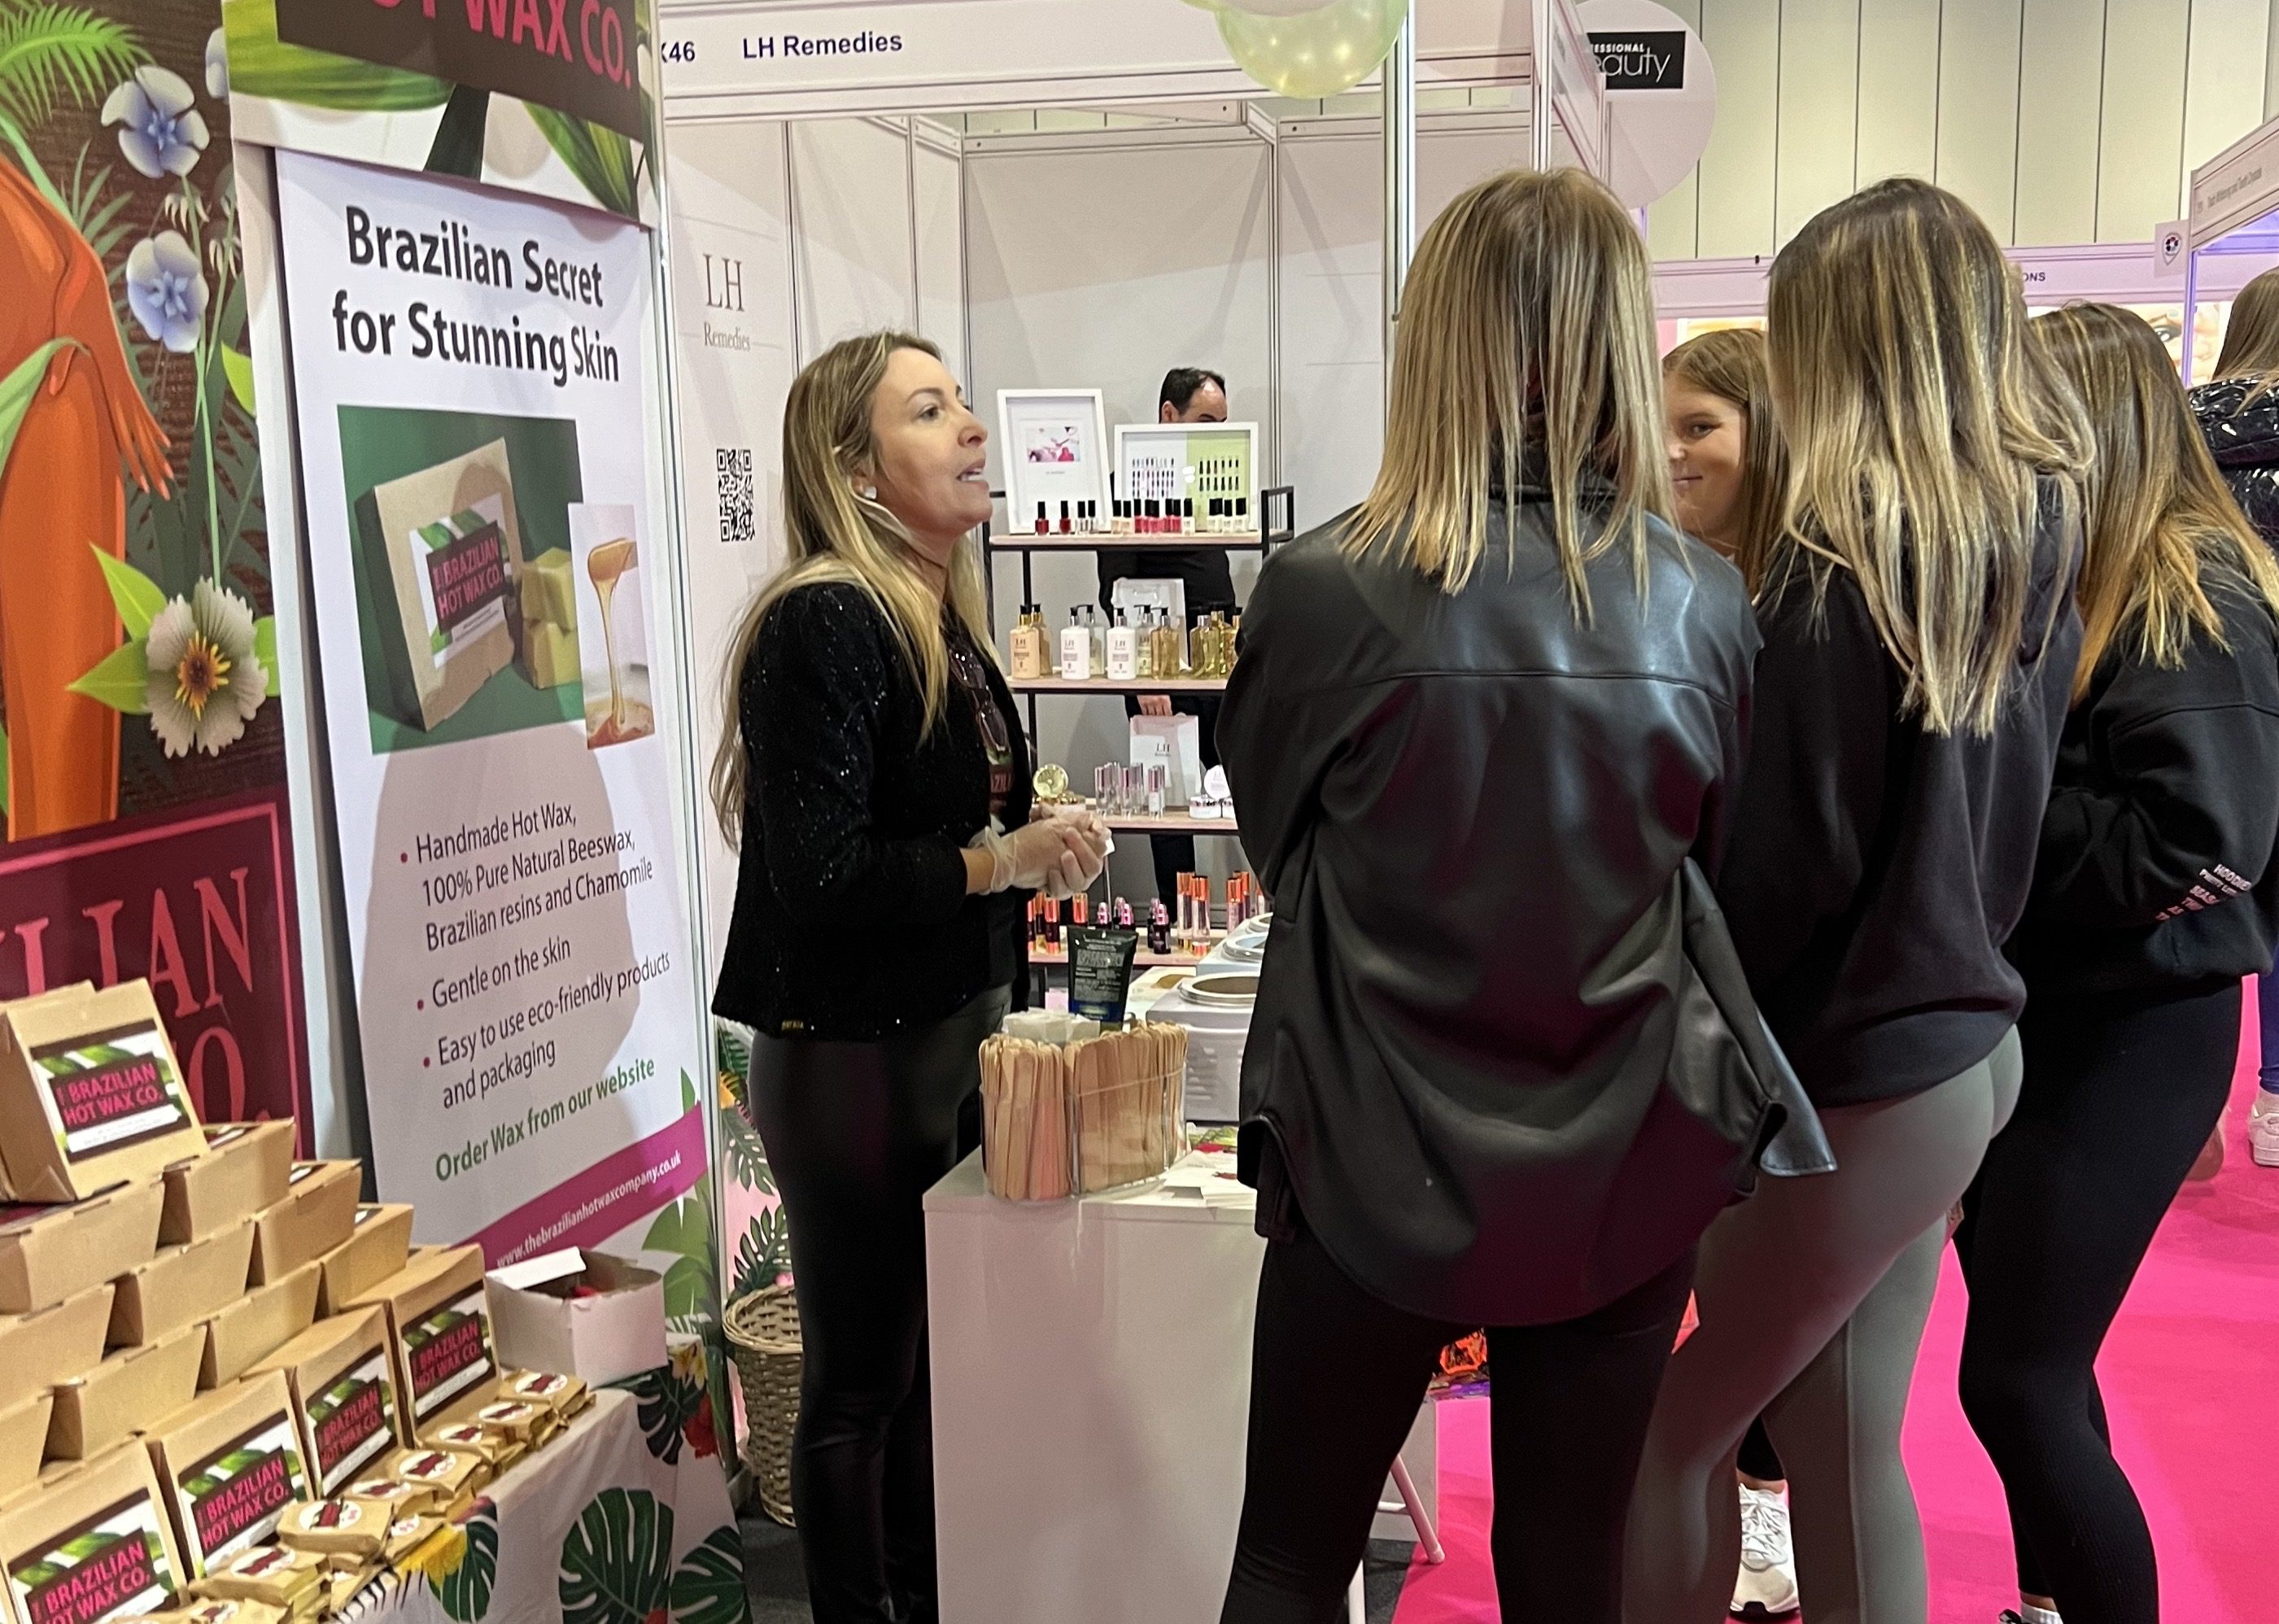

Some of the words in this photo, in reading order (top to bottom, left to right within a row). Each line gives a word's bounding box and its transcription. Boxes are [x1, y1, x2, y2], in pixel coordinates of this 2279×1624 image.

[581, 0, 632, 91] CO.
[743, 37, 774, 59] LH
[784, 31, 902, 57] Remedies
[1591, 43, 1645, 54] ESSIONAL
[346, 205, 513, 289] Brazilian
[522, 240, 604, 308] Secret
[703, 254, 744, 312] LH
[332, 289, 395, 356] for
[408, 302, 567, 387] Stunning
[571, 325, 619, 382] Skin
[704, 321, 751, 352] Remedies
[442, 535, 500, 587] BRAZILIAN
[438, 587, 463, 619] HOT
[463, 574, 487, 605] WAX
[416, 815, 509, 864] Handmade
[512, 810, 539, 840] Hot
[540, 802, 577, 830] Wax,
[422, 869, 474, 907] 100%
[476, 862, 509, 893] Pure
[512, 840, 565, 882] Natural
[569, 828, 636, 865] Beeswax,
[426, 910, 497, 952] Brazilian
[500, 893, 543, 927] resins
[545, 879, 573, 912] and
[575, 856, 653, 902] Chamomile
[432, 964, 489, 1008] Gentle
[491, 964, 513, 987] on
[513, 948, 539, 978] the
[543, 935, 571, 968] skin
[438, 1031, 478, 1067] Easy
[480, 1023, 497, 1050] to
[499, 1013, 526, 1041] use
[527, 971, 615, 1028] eco-friendly
[617, 950, 671, 998] products
[63, 1102, 98, 1126] HOT
[97, 1090, 135, 1116] WAX
[136, 1085, 163, 1105] CO.
[68, 1063, 157, 1104] BRAZILIAN
[443, 1075, 477, 1110] and
[479, 1038, 556, 1099] packaging
[435, 1139, 489, 1181] Order
[491, 1119, 525, 1156] Wax
[527, 1100, 565, 1137] from
[568, 1083, 593, 1115] our
[595, 1057, 656, 1102] website
[496, 1149, 682, 1268] www.thebrazilianhotwaxcompany.co.uk
[419, 1319, 479, 1369] BRAZILIAN
[203, 1517, 230, 1551] HOT
[230, 1495, 264, 1529] WAX
[264, 1482, 290, 1506] CO.
[207, 1456, 284, 1523] BRAZILIAN
[45, 1540, 145, 1614] BRAZILIAN
[76, 1583, 119, 1621] WAX
[120, 1565, 151, 1594] CO.
